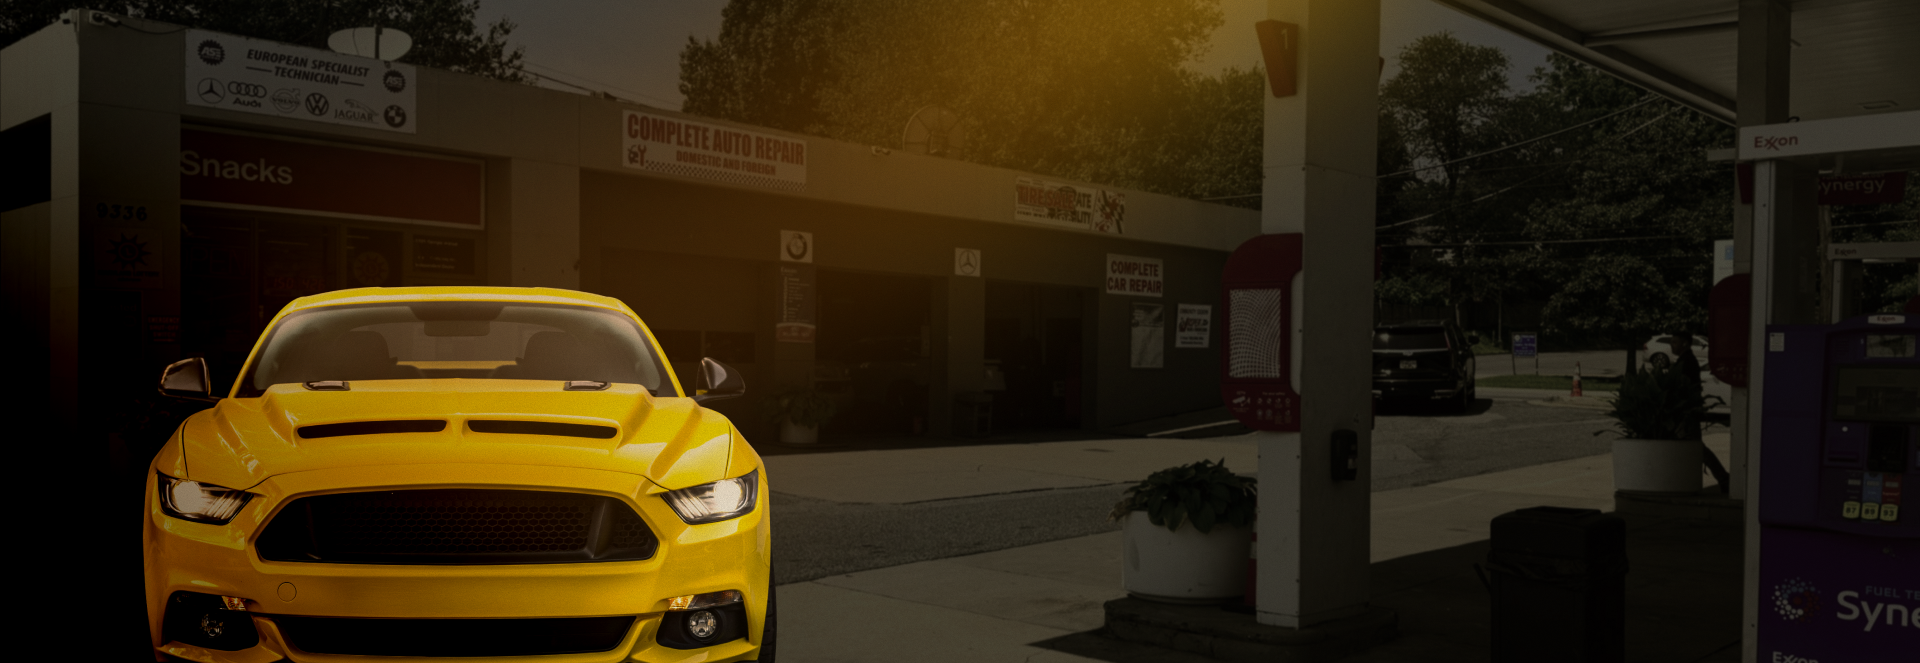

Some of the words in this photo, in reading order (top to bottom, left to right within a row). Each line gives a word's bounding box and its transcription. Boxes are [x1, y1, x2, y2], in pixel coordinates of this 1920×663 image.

[247, 49, 308, 67] EUROPEAN
[312, 60, 370, 77] SPECIALIST
[274, 67, 340, 85] TECHNICIAN
[233, 97, 262, 108] Audi
[272, 97, 300, 105] VOLVO
[334, 109, 373, 122] JAGUAR
[627, 113, 709, 150] COMPLETE
[713, 129, 752, 157] AUTO
[755, 136, 804, 165] REPAIR
[1754, 136, 1799, 151] Exxon
[180, 149, 293, 185] Snacks
[676, 150, 722, 168] DOMESTIC
[723, 158, 740, 171] AND
[741, 161, 776, 176] FOREIGN
[1818, 178, 1885, 196] ynergy
[1017, 185, 1045, 205] TIRE
[1045, 190, 1075, 211] SALE
[1076, 192, 1092, 209] ATE
[96, 202, 147, 221] 9336
[1111, 260, 1159, 277] COMPLETE
[1107, 277, 1127, 291] CAR
[1129, 278, 1162, 294] REPAIR
[1876, 315, 1896, 323] Exxon
[1865, 585, 1901, 599] FUEL
